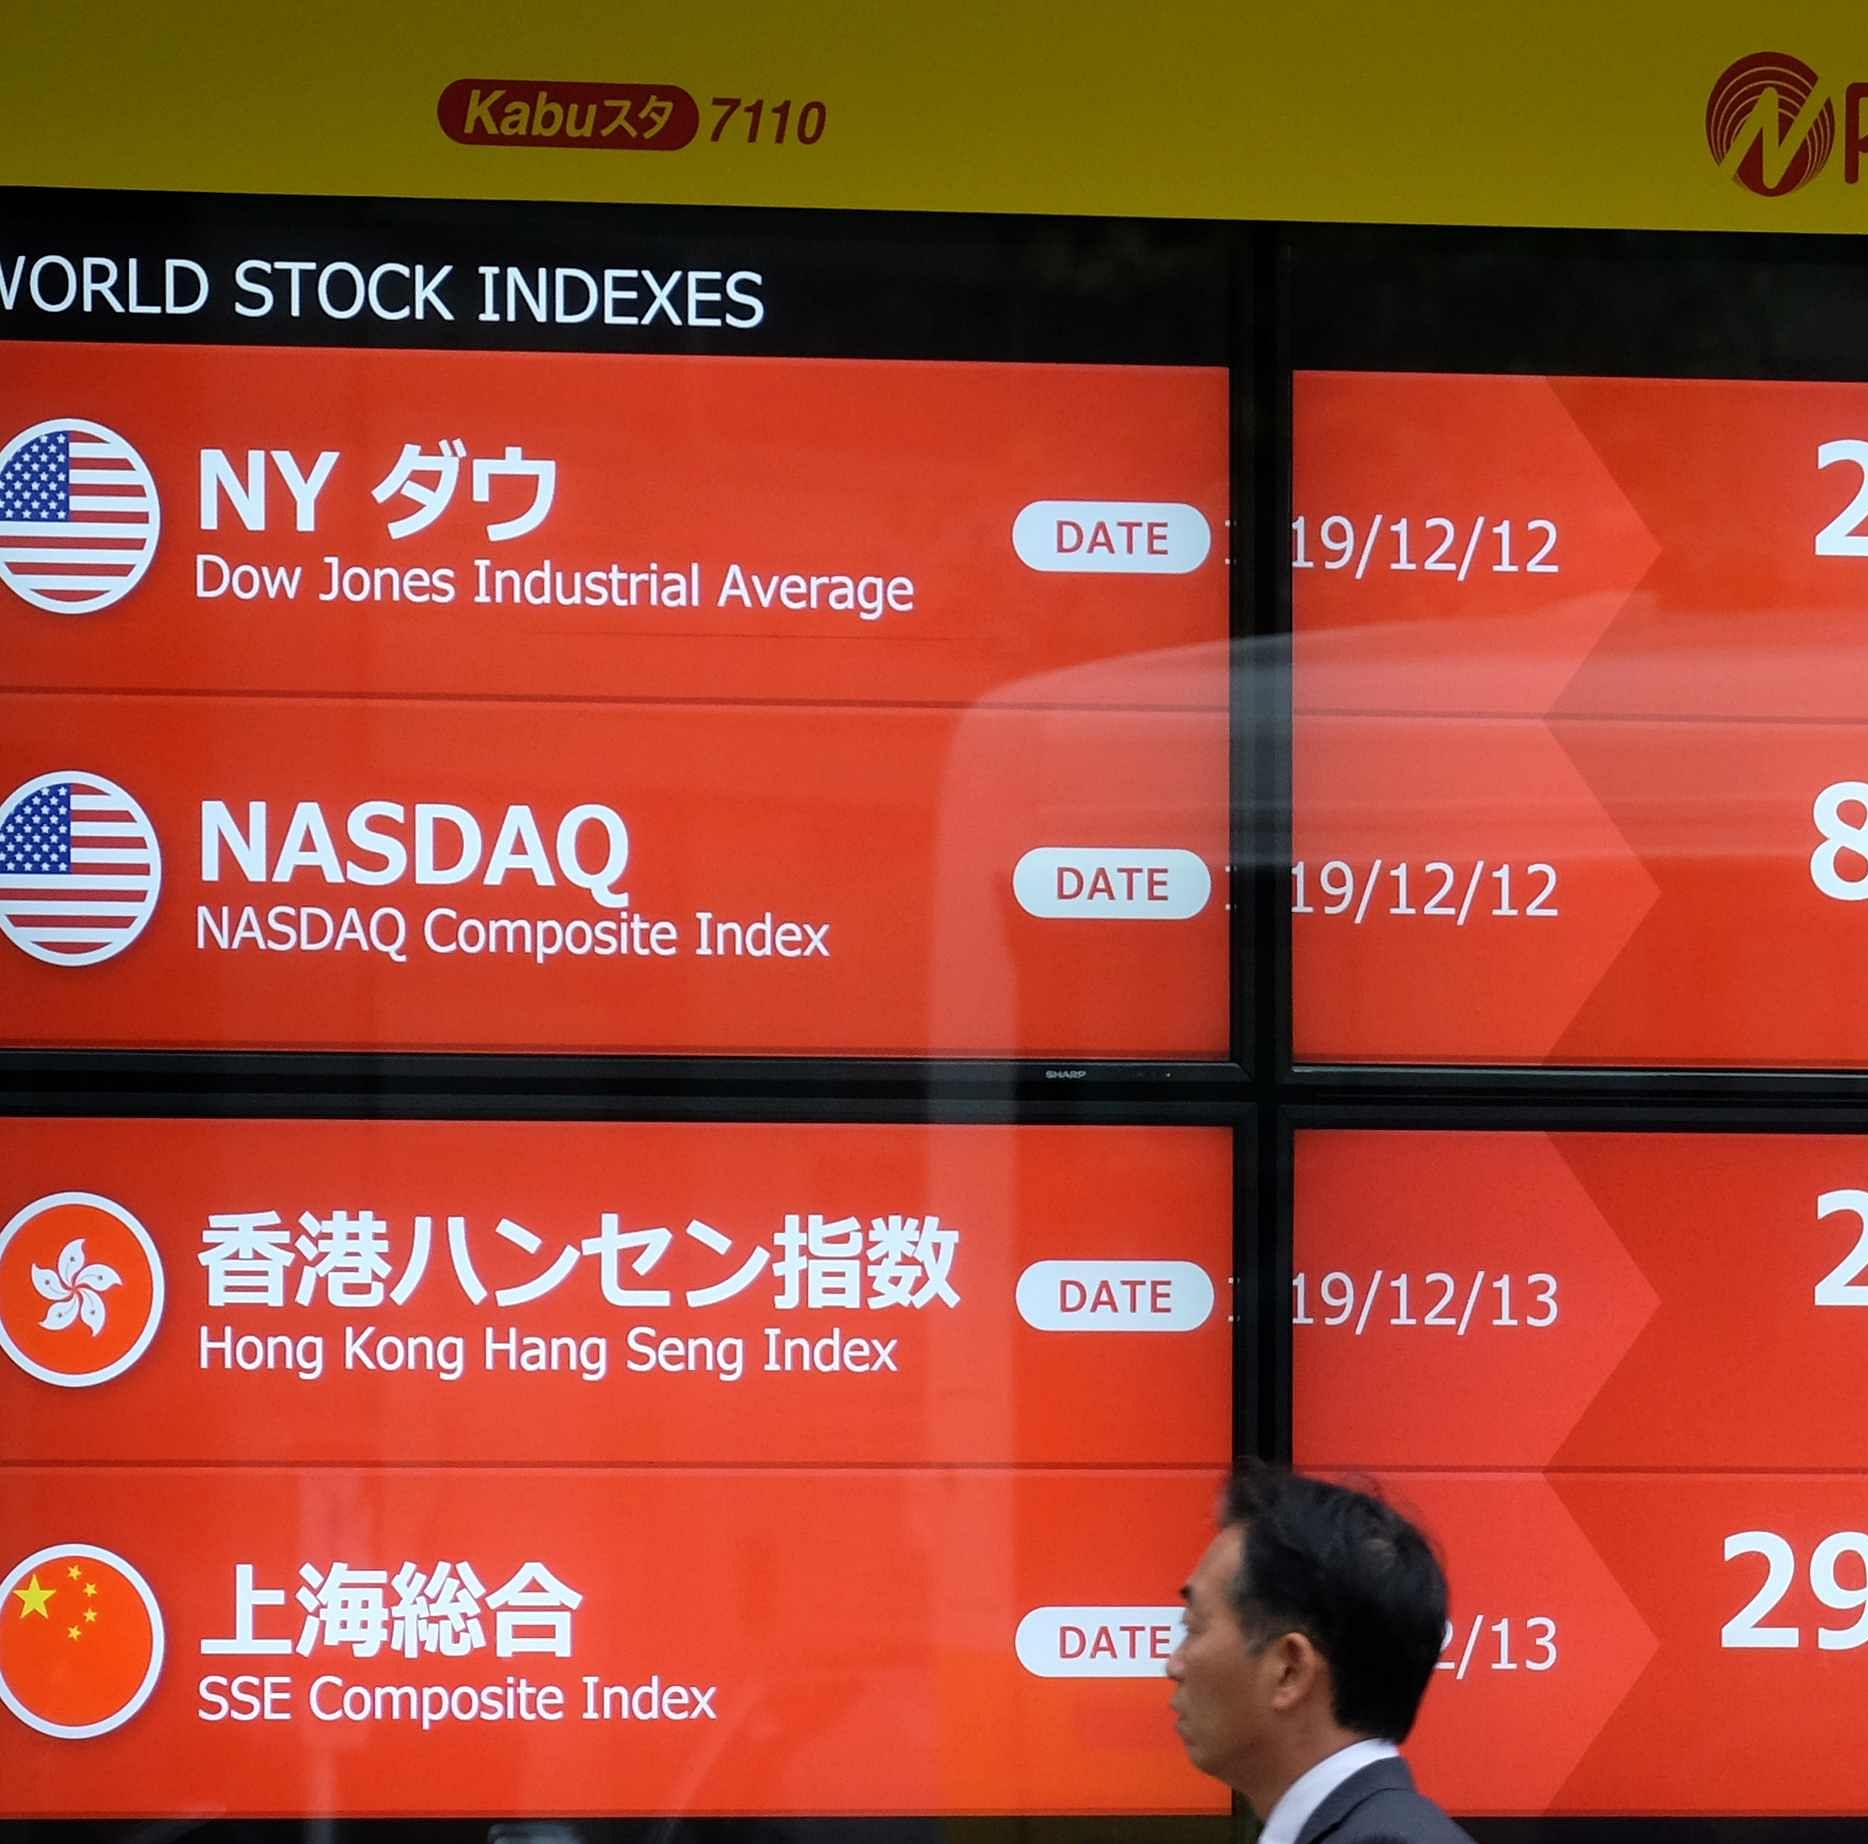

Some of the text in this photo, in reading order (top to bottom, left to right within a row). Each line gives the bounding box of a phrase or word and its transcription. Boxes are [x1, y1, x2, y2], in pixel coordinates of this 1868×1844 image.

[464, 90, 826, 144] Kabuスタ 7110
[235, 260, 454, 320] STOCK
[479, 266, 764, 328] INDEXES
[201, 439, 556, 541] NY ダウ
[1057, 521, 1168, 555] DATE
[1292, 515, 1558, 581] 19/12/12
[197, 555, 913, 620] Dow Jones Industrial Average
[198, 801, 629, 905] NASDAQ
[1058, 867, 1168, 900] DATE
[1292, 859, 1558, 925] 19/12/12
[198, 906, 829, 963] NASDAQ Composite Index
[1045, 1070, 1087, 1079] SHARP
[198, 1211, 960, 1309] 香港ハンセン指数
[1060, 1280, 1171, 1313] DATE
[1293, 1270, 1557, 1335] 19/12/13
[201, 1326, 897, 1381] Hong Kong Hang Seng Index
[201, 1561, 583, 1658] 上海総合
[1060, 1626, 1171, 1659] DATE
[199, 1675, 716, 1730] SSE Composite Index
